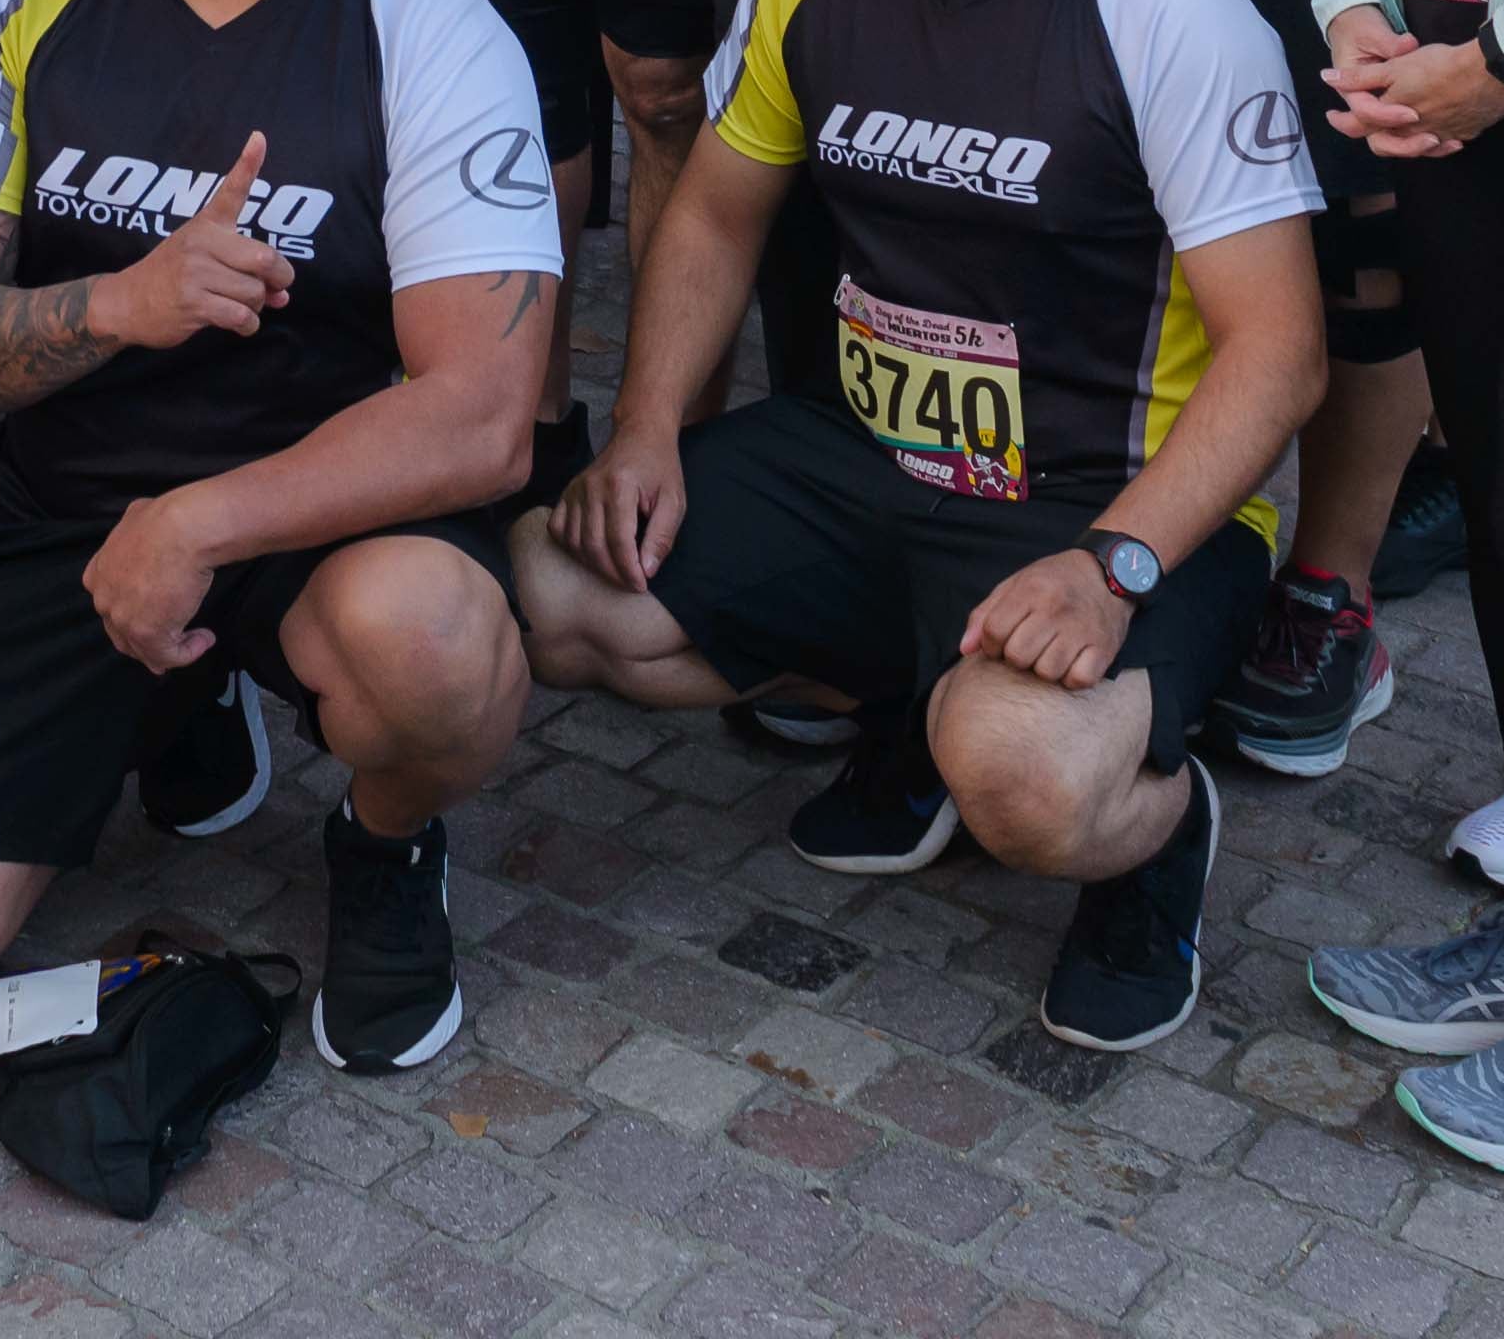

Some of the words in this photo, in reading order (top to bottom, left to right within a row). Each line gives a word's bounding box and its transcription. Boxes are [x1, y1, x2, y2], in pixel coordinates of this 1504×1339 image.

[817, 103, 1052, 184] LONGO
[817, 141, 903, 178] TOYOTA
[906, 161, 1039, 204] LEXUS
[34, 188, 148, 233] TOYOTA
[874, 306, 892, 321] Day
[905, 315, 920, 327] the
[922, 319, 951, 331] Dead
[887, 323, 952, 344] MUERTOS
[954, 327, 985, 347] 5k
[845, 339, 1011, 456] 3740
[896, 449, 955, 481] LONGO
